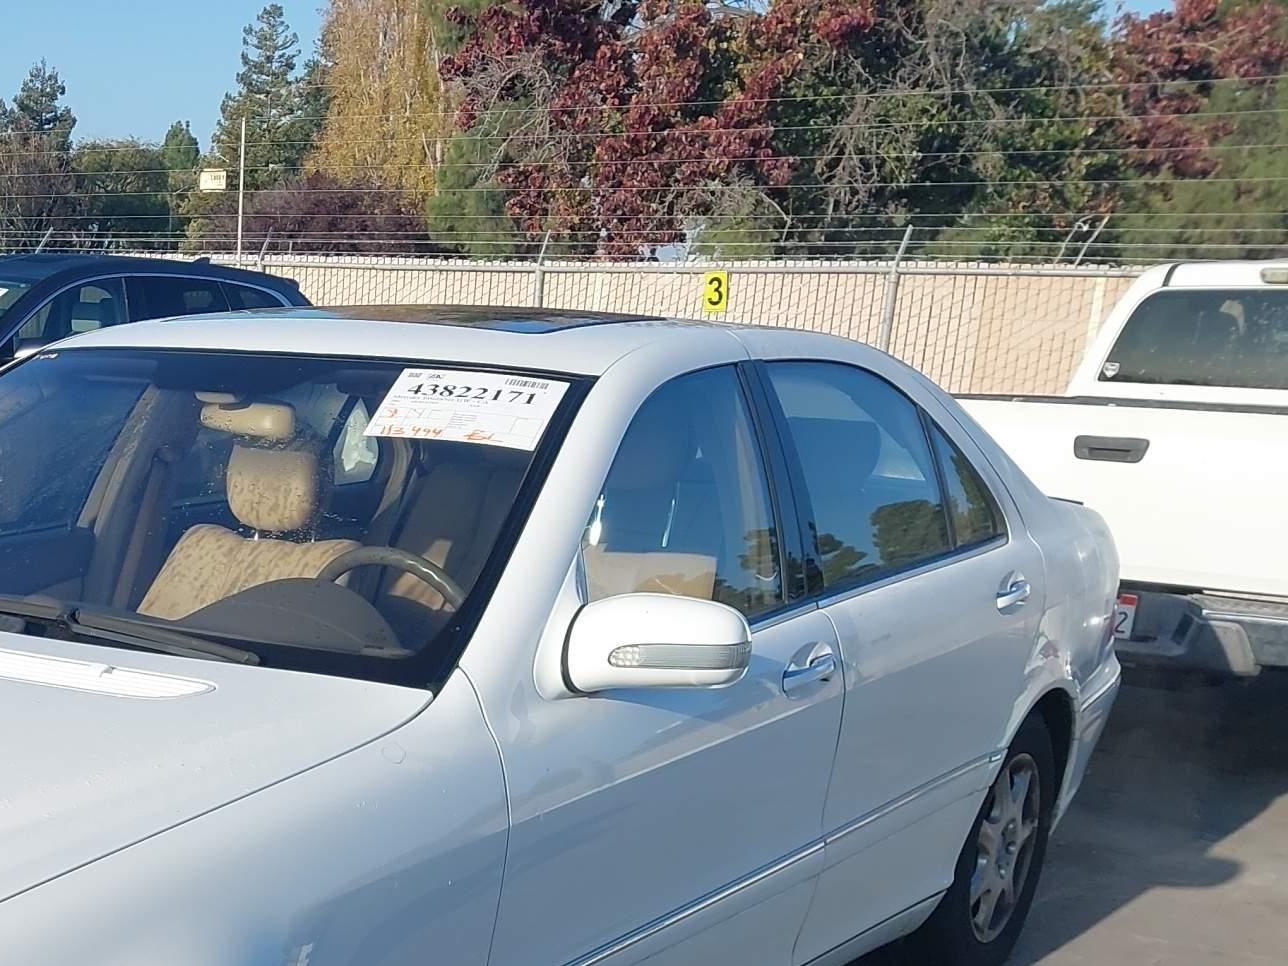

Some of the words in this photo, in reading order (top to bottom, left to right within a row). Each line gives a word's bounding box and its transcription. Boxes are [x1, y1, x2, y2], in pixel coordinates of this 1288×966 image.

[707, 276, 723, 306] 3
[407, 383, 537, 405] 43822171
[1115, 611, 1128, 634] 2
